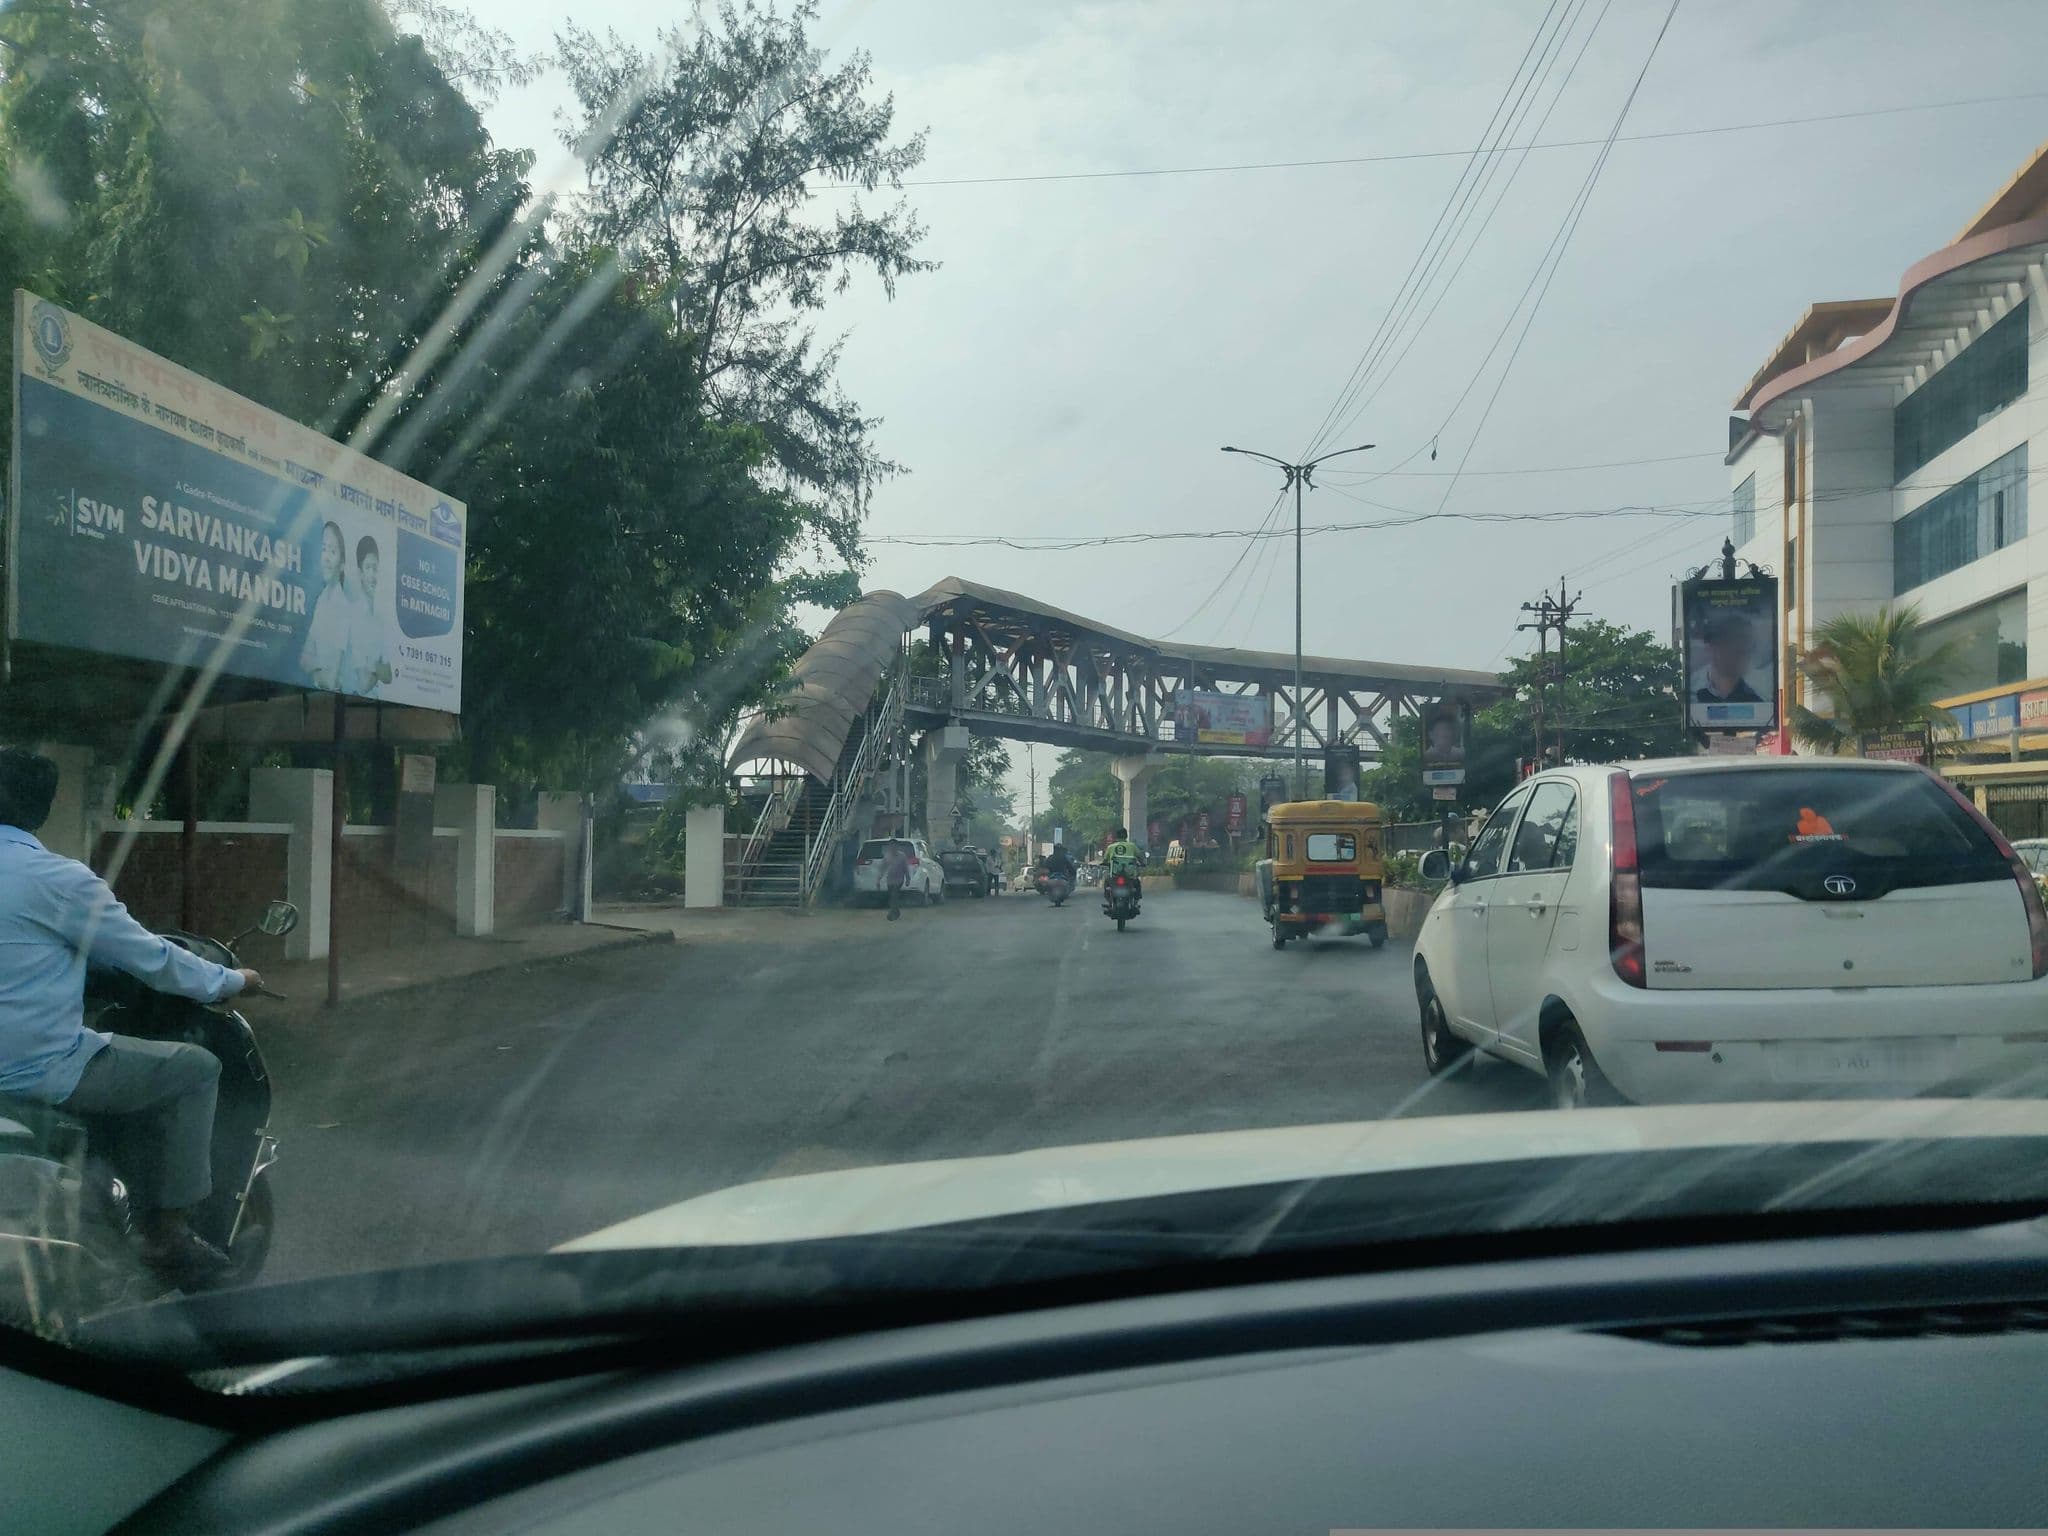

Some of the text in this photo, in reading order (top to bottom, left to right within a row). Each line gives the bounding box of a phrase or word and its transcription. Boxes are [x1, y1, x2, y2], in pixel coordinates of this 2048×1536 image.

[77, 497, 125, 534] SVM
[140, 495, 302, 574] SARVANKASH
[134, 539, 307, 616] VIDYA MANDIR
[401, 574, 450, 601] CBSE SCHOOL
[400, 594, 450, 621] in RATNAGIRI
